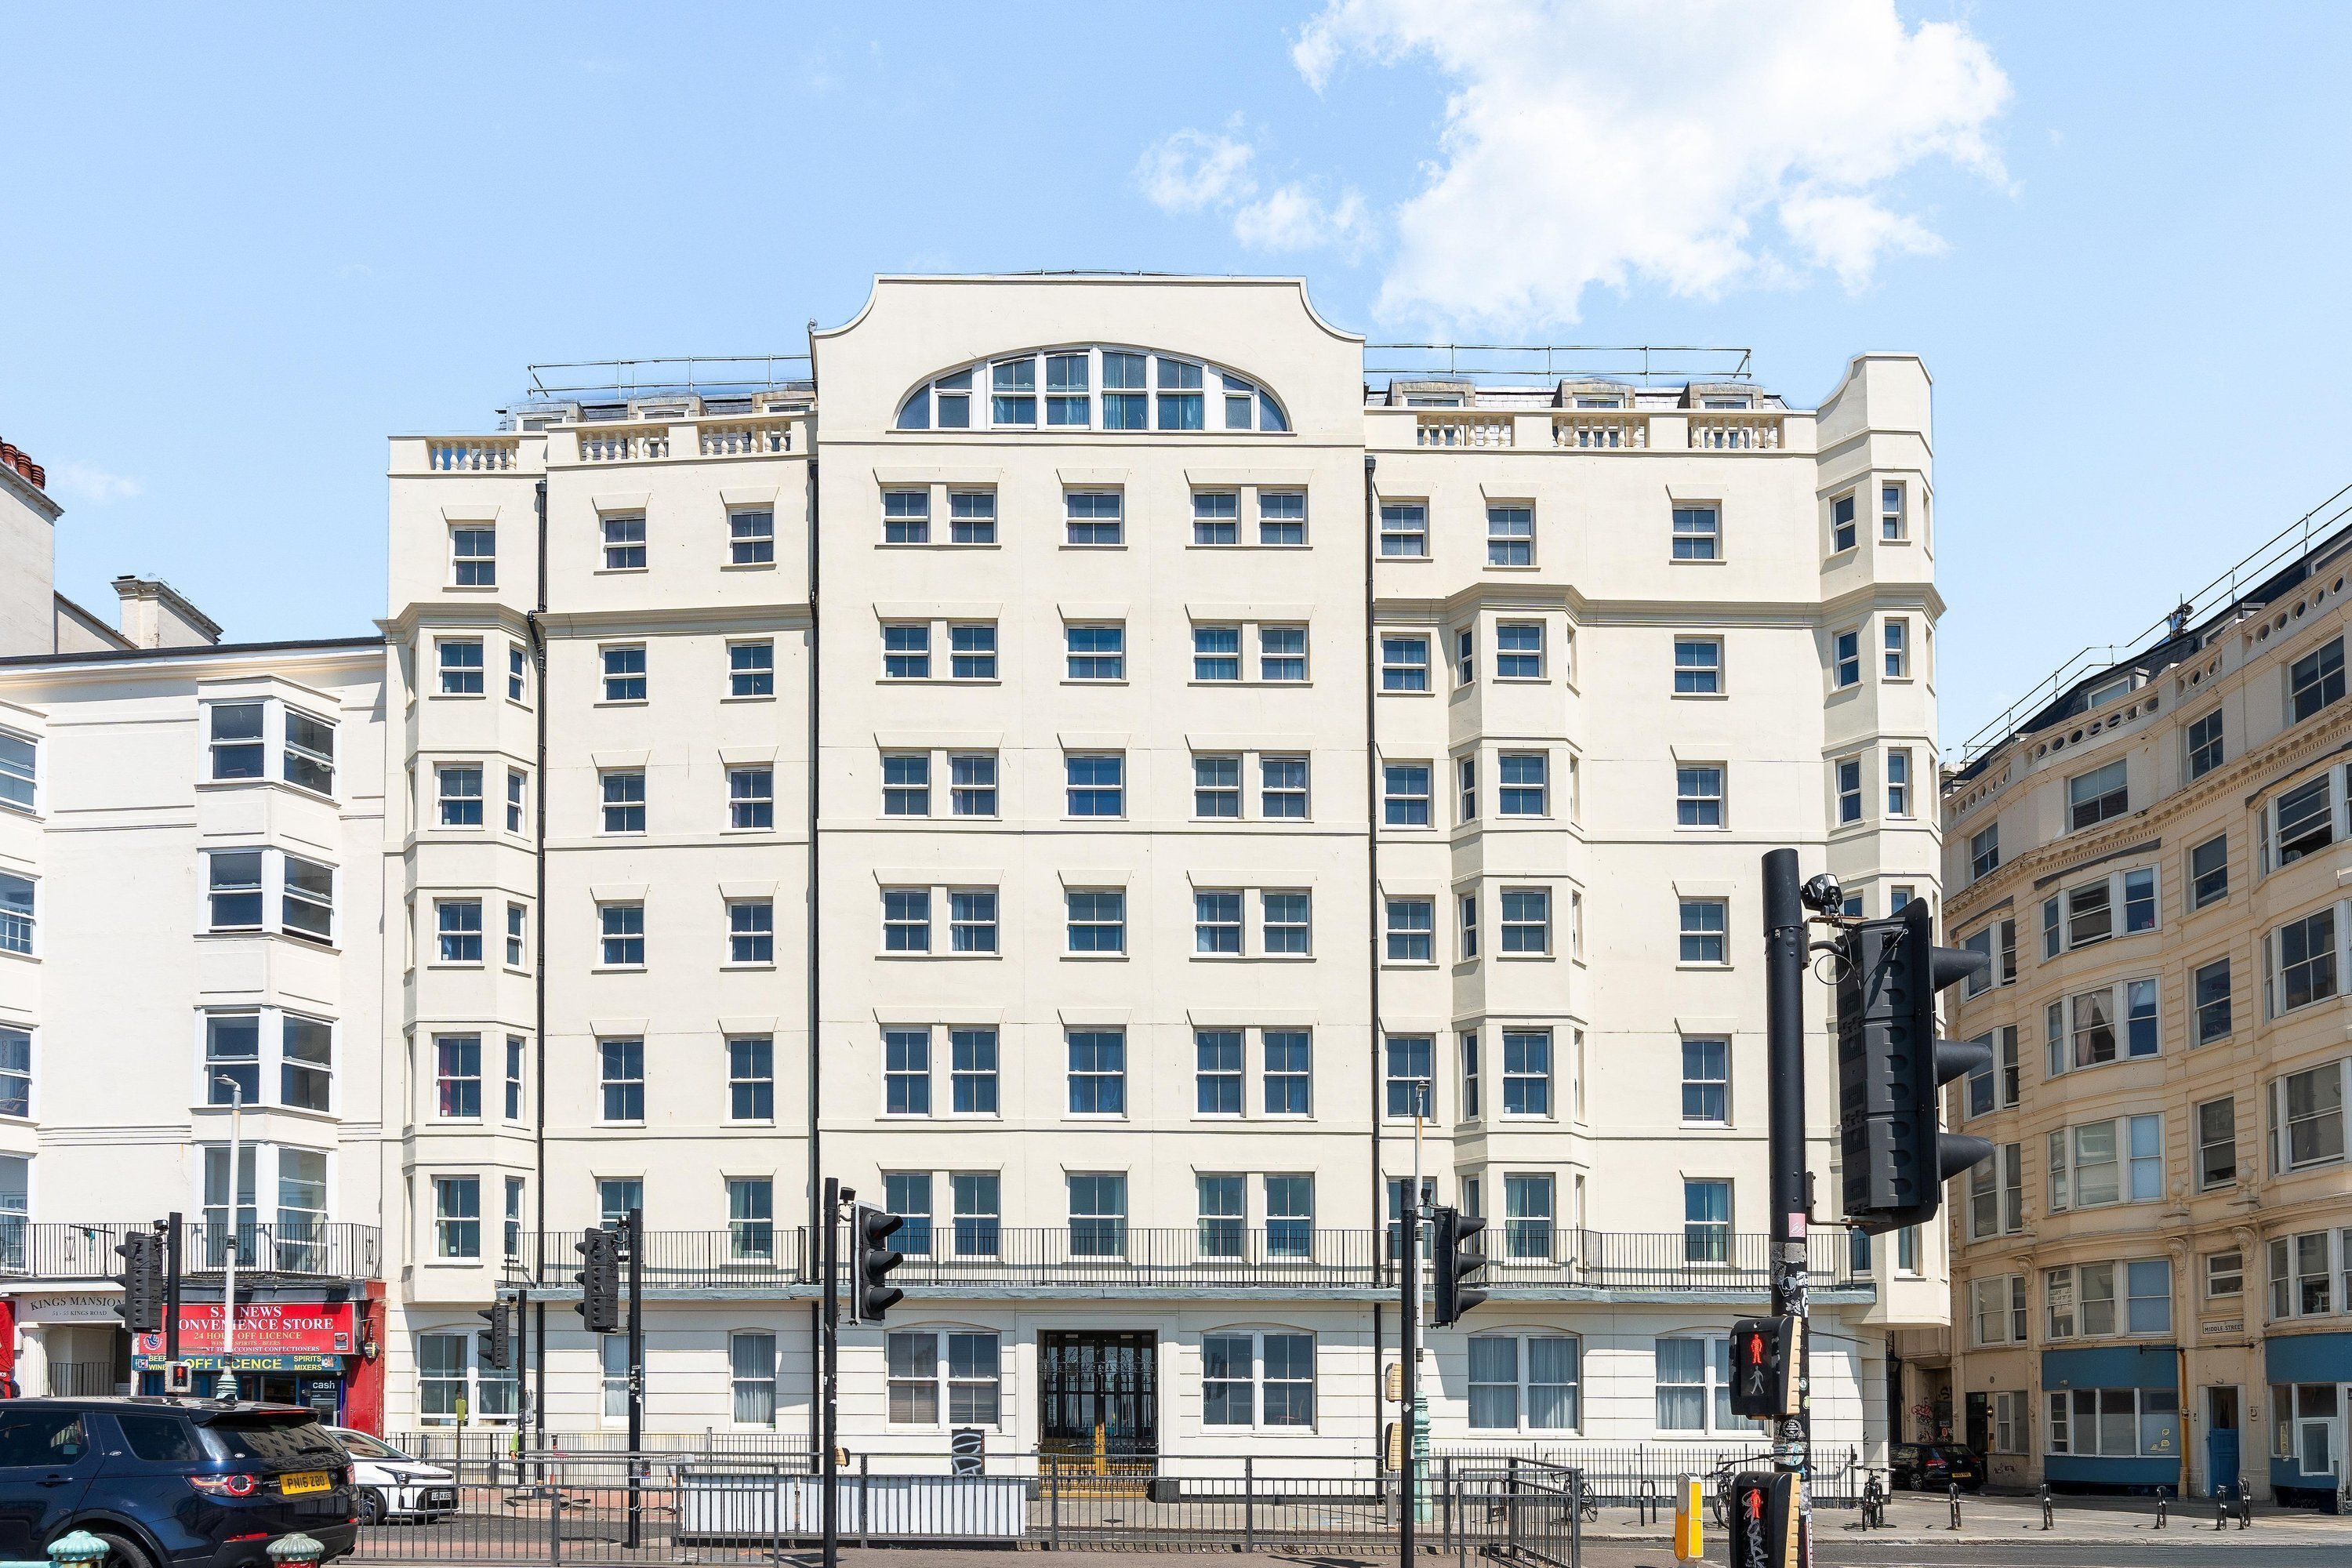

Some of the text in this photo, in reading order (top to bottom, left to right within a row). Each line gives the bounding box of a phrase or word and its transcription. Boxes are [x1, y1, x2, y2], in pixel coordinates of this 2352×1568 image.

[30, 1297, 66, 1311] KINGS
[240, 1306, 282, 1317] NEWS
[178, 1318, 334, 1330] ONVEIENCE STORE
[184, 1359, 282, 1370] OFF LCENCE
[312, 1380, 336, 1389] cash
[286, 1476, 309, 1490] PN16
